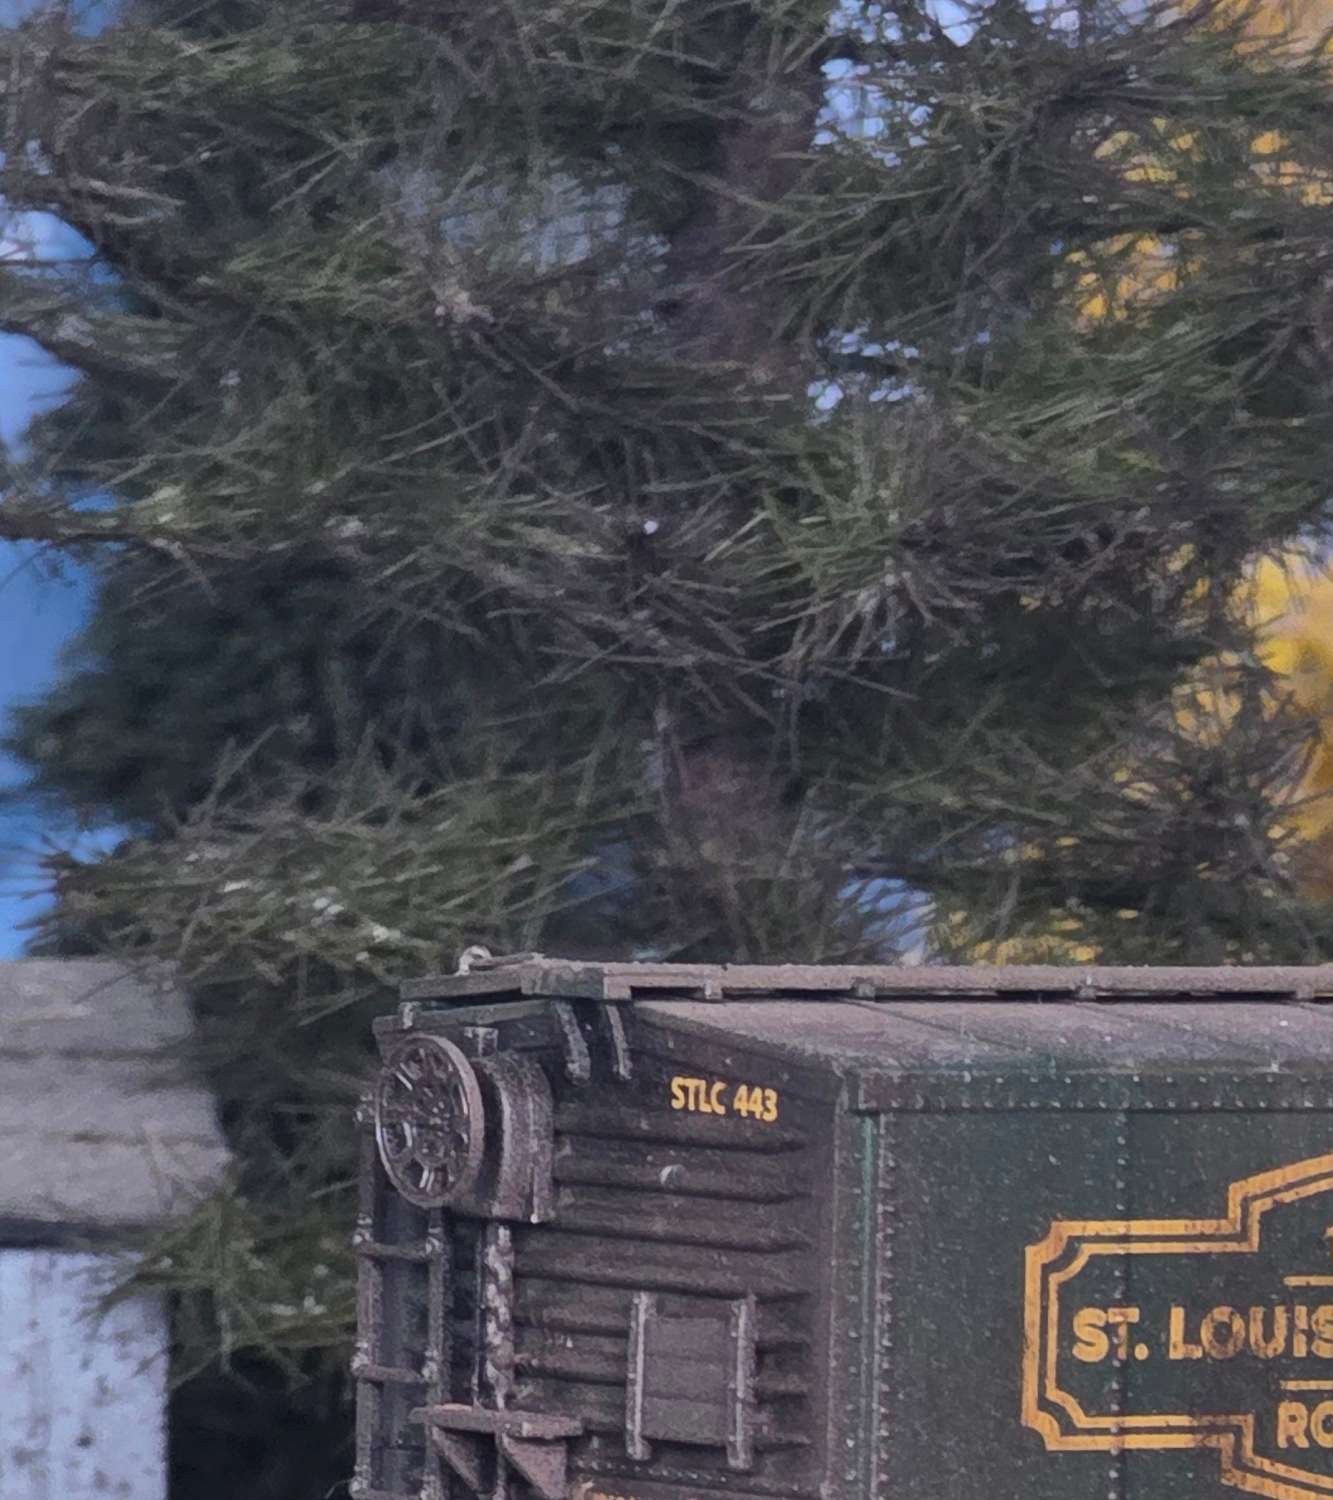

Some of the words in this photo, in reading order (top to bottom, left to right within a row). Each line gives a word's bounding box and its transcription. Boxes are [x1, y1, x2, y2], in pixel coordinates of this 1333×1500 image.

[671, 1076, 727, 1115] STLC
[733, 1084, 778, 1122] 443
[1071, 1306, 1149, 1362] ST.
